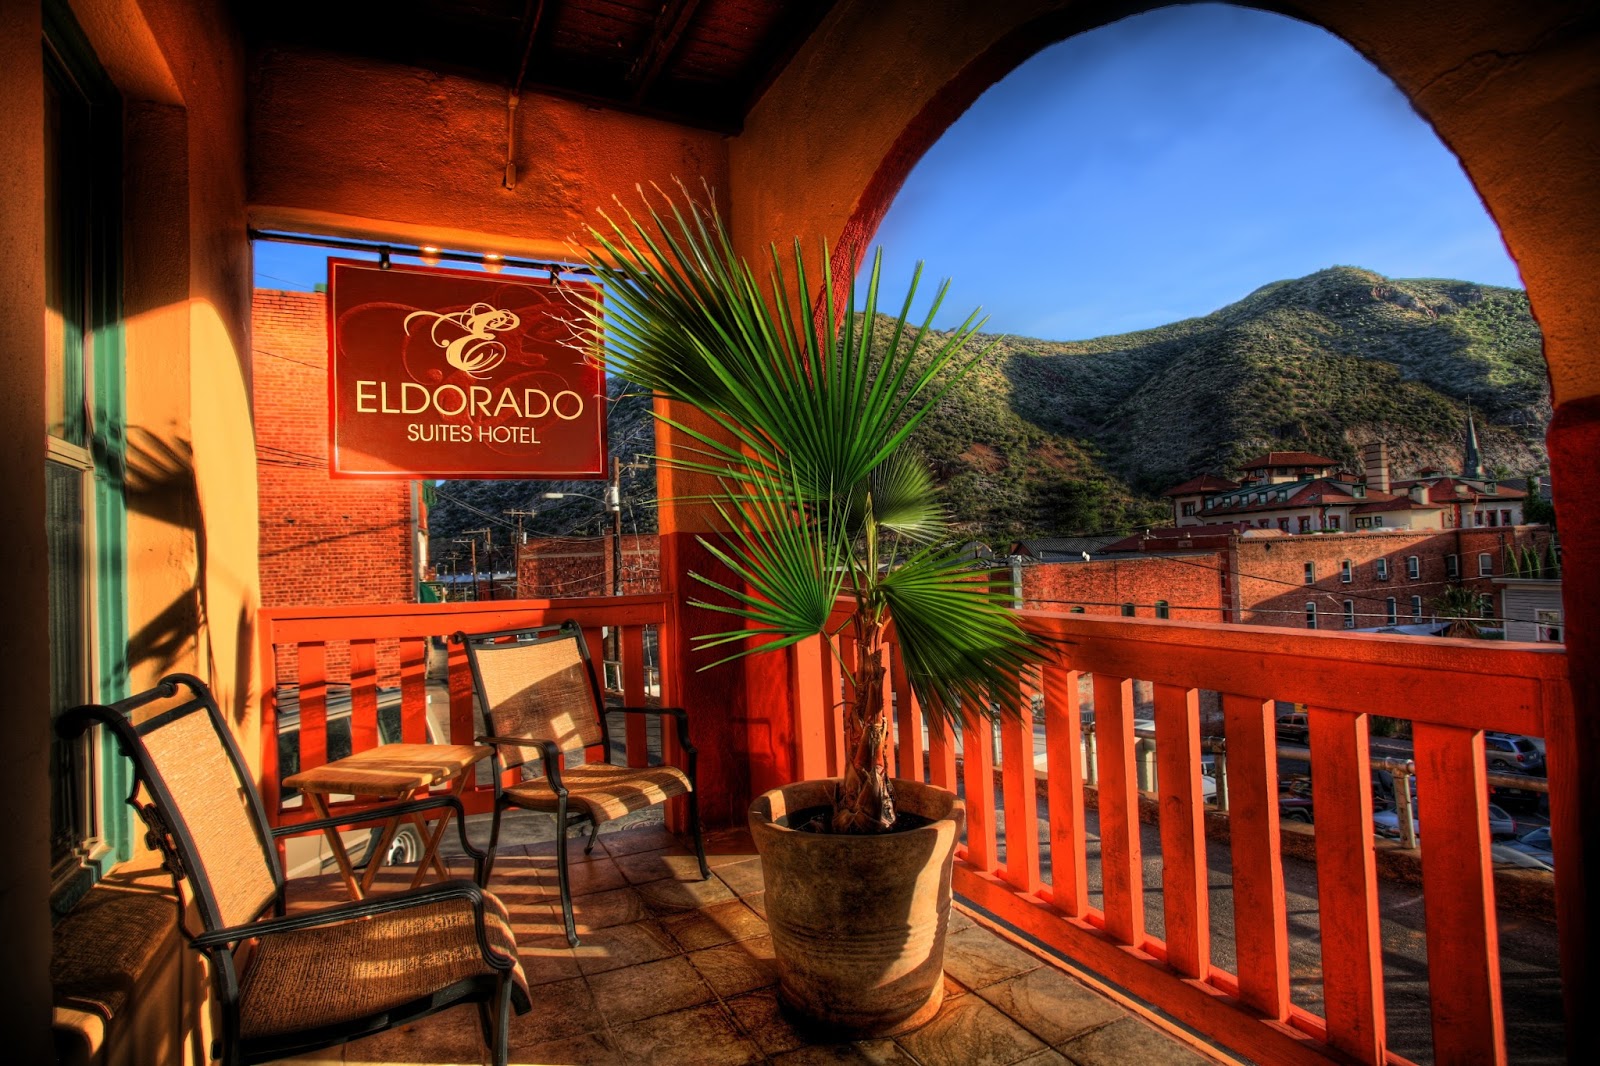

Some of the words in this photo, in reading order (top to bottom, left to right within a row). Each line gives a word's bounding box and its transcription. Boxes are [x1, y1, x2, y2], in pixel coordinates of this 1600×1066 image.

[356, 381, 584, 420] ELDORADO
[407, 424, 473, 442] SUITES
[479, 426, 541, 444] HOTEL
